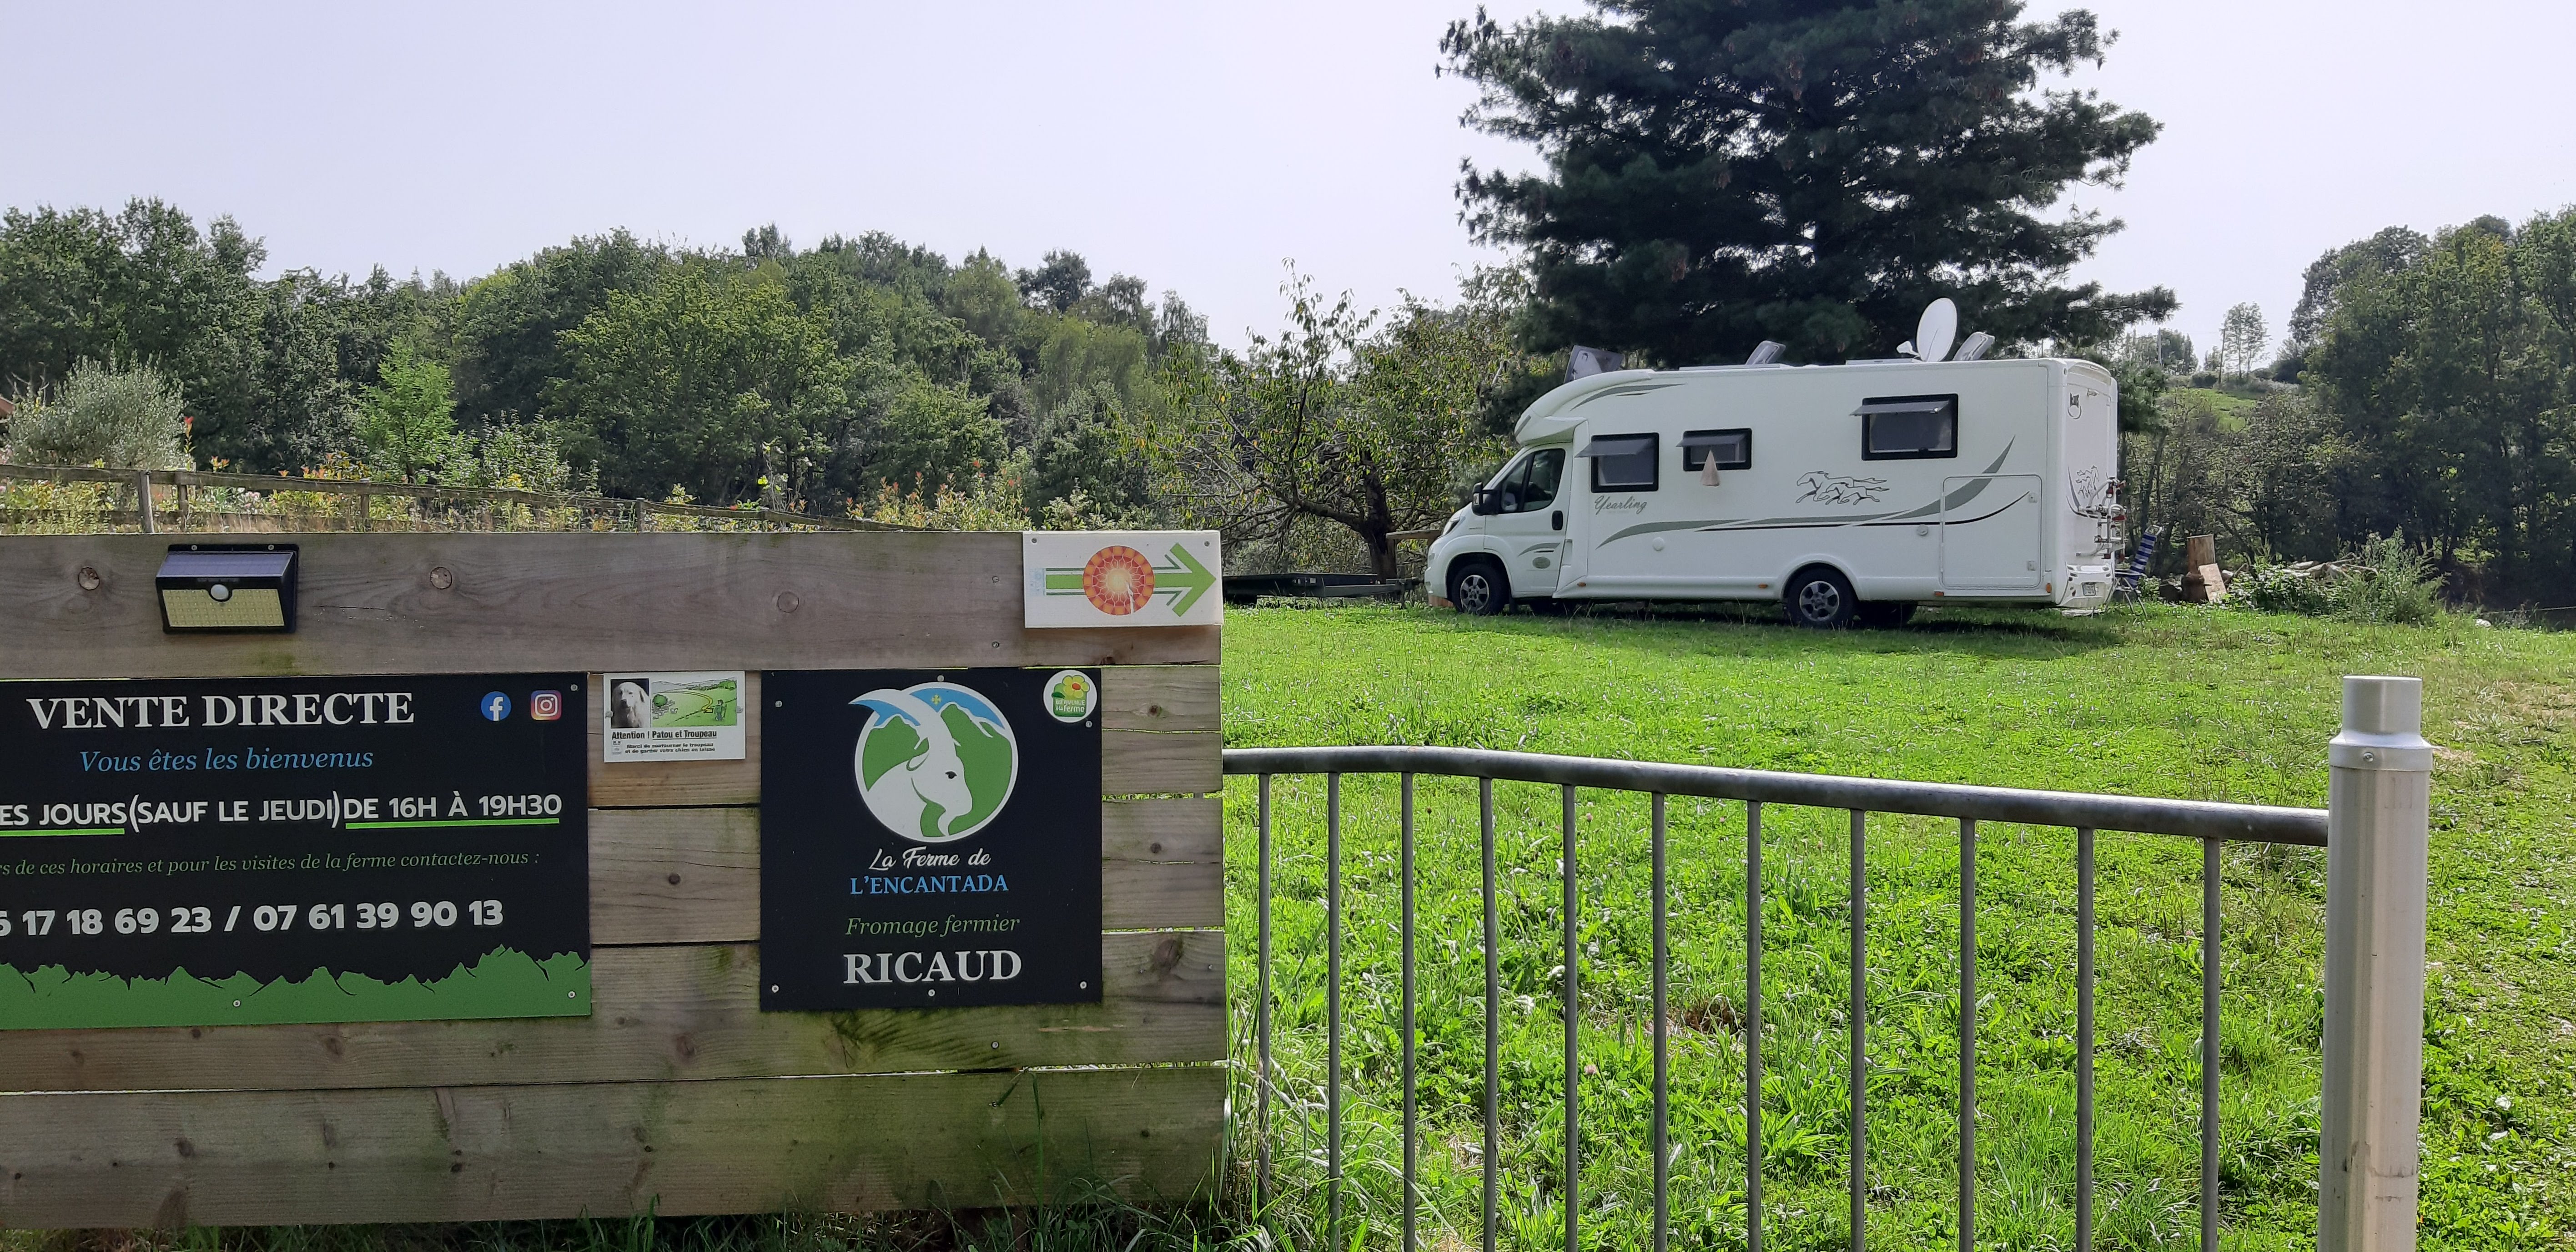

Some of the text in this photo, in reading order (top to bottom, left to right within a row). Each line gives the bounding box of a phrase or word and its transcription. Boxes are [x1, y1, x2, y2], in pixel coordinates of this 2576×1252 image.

[1595, 495, 1647, 515] Yearling
[26, 692, 414, 729] VENTE DIRECTE
[611, 731, 645, 740] Attention
[652, 730, 674, 738] Patou
[684, 730, 717, 738] Troupeau
[80, 747, 373, 772] Vous êtes les bienvenus
[219, 801, 249, 822] LE
[389, 797, 437, 818] 16H
[448, 791, 468, 817] À
[479, 794, 562, 816] 19H30
[15, 859, 35, 875] de
[40, 863, 65, 874] ces
[70, 858, 143, 874] horaires
[148, 859, 164, 872] et
[166, 861, 210, 876] pour
[215, 856, 236, 871] les
[242, 855, 295, 870] visites
[301, 853, 320, 869] de
[326, 853, 341, 868] la
[342, 853, 396, 872] ferme
[401, 853, 528, 867] contactez-nous
[868, 846, 991, 871] La Ferme de
[22, 910, 55, 935] 17
[66, 909, 103, 934] 18
[115, 908, 159, 934] 69
[171, 907, 212, 933] 23
[224, 906, 241, 932] /
[253, 905, 297, 931] 07
[308, 904, 344, 929] 61
[357, 902, 399, 929] 39
[410, 901, 458, 927] 90
[468, 899, 503, 925] 13
[845, 914, 1020, 938] Fromage fermier
[843, 950, 1021, 984] RICAUD
